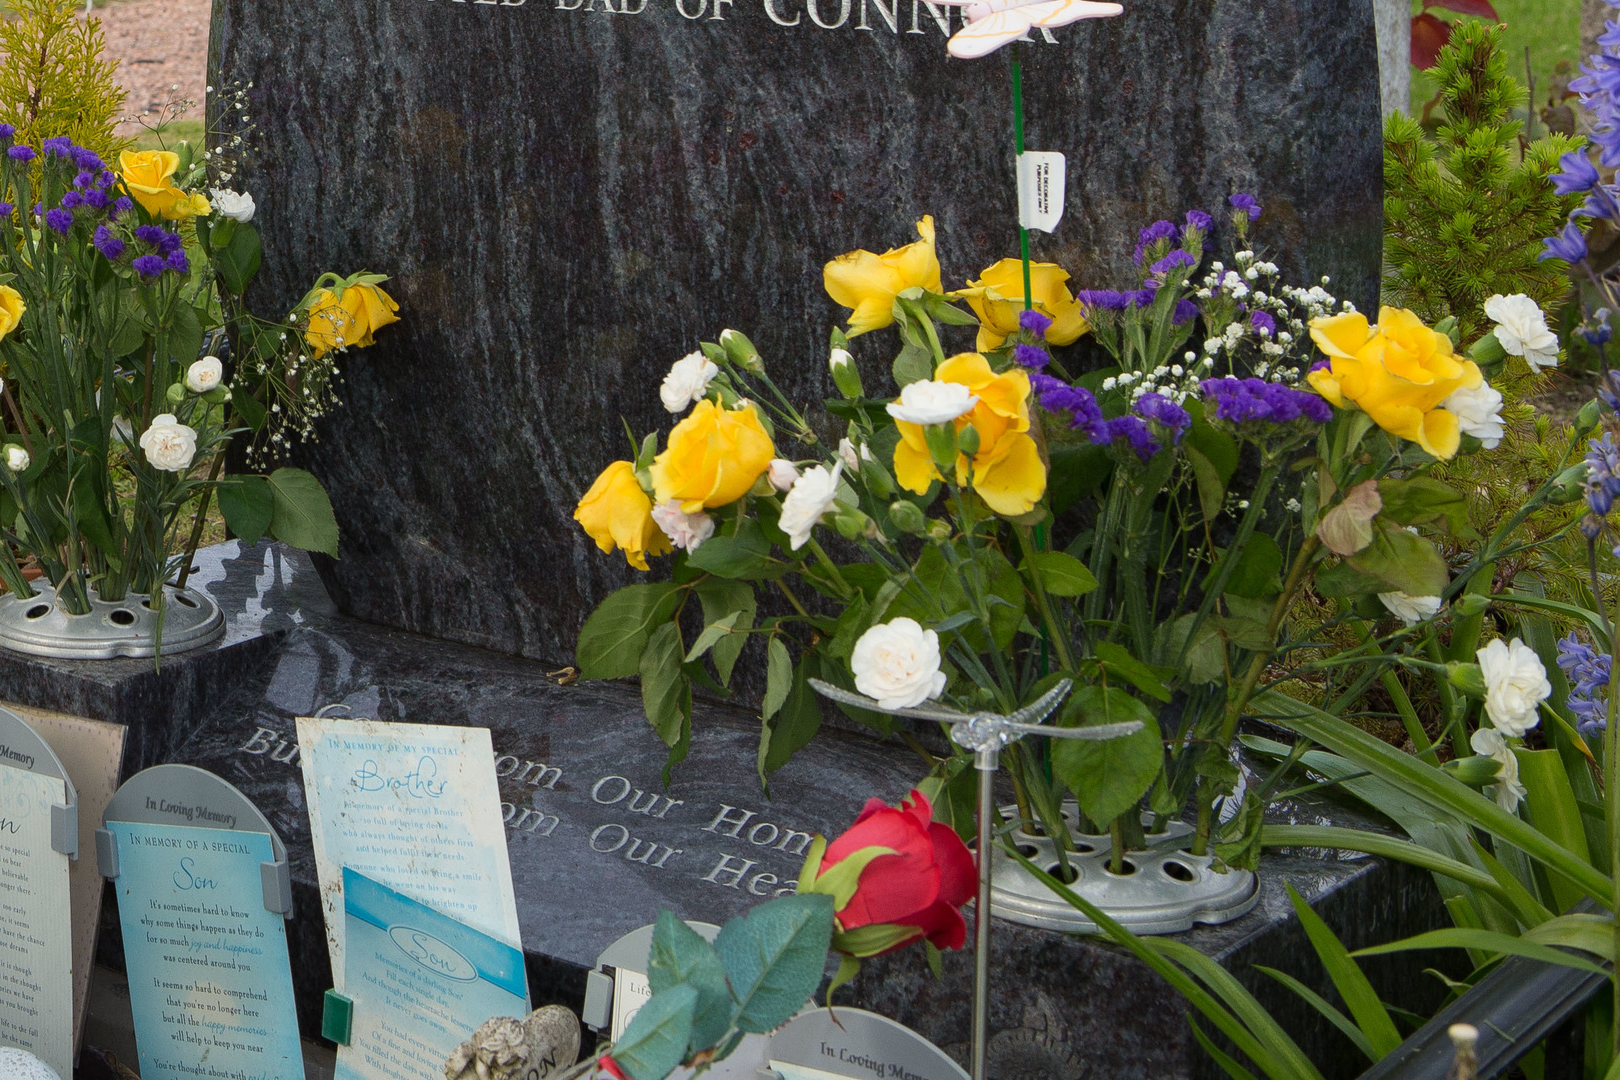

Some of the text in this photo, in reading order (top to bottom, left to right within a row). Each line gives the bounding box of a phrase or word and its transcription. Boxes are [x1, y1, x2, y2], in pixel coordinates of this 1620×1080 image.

[0, 744, 35, 770] Memory
[344, 741, 383, 752] MEMORY
[404, 745, 417, 753] MY
[421, 746, 459, 756] SPECIAL
[354, 755, 448, 799] Brother
[238, 726, 301, 767] Bu
[589, 823, 683, 869] Our
[590, 775, 685, 819] Our
[145, 796, 237, 828] In Loving Memory
[129, 832, 250, 855] IN MEMORY OF A SPECIAL
[172, 856, 219, 890] Son
[13, 905, 26, 916] early
[149, 899, 250, 919] It's sometimes hard to know
[140, 915, 154, 928] why
[156, 920, 174, 928] some
[176, 918, 199, 932] things
[200, 920, 226, 935] happen
[238, 926, 253, 939] they
[254, 927, 264, 938] do
[146, 932, 158, 943] for
[169, 935, 189, 947] much
[190, 939, 202, 953] joy
[204, 938, 222, 950] and
[223, 939, 262, 956] happiness
[410, 933, 457, 973] Son
[163, 955, 251, 972] was centered around you
[154, 978, 160, 988] It
[162, 981, 183, 990] seems
[195, 981, 211, 994] hard
[214, 986, 222, 994] to
[224, 988, 268, 1001] comprehend
[166, 995, 259, 1018] that you're no longer here
[162, 1011, 268, 1037] but all the happy memories
[171, 1031, 263, 1053] will help to keep you near
[154, 1058, 176, 1071] You're
[178, 1060, 206, 1076] thought
[208, 1065, 229, 1078] about
[231, 1067, 247, 1080] with
[821, 1041, 835, 1058] In
[839, 1048, 885, 1078] Loving
